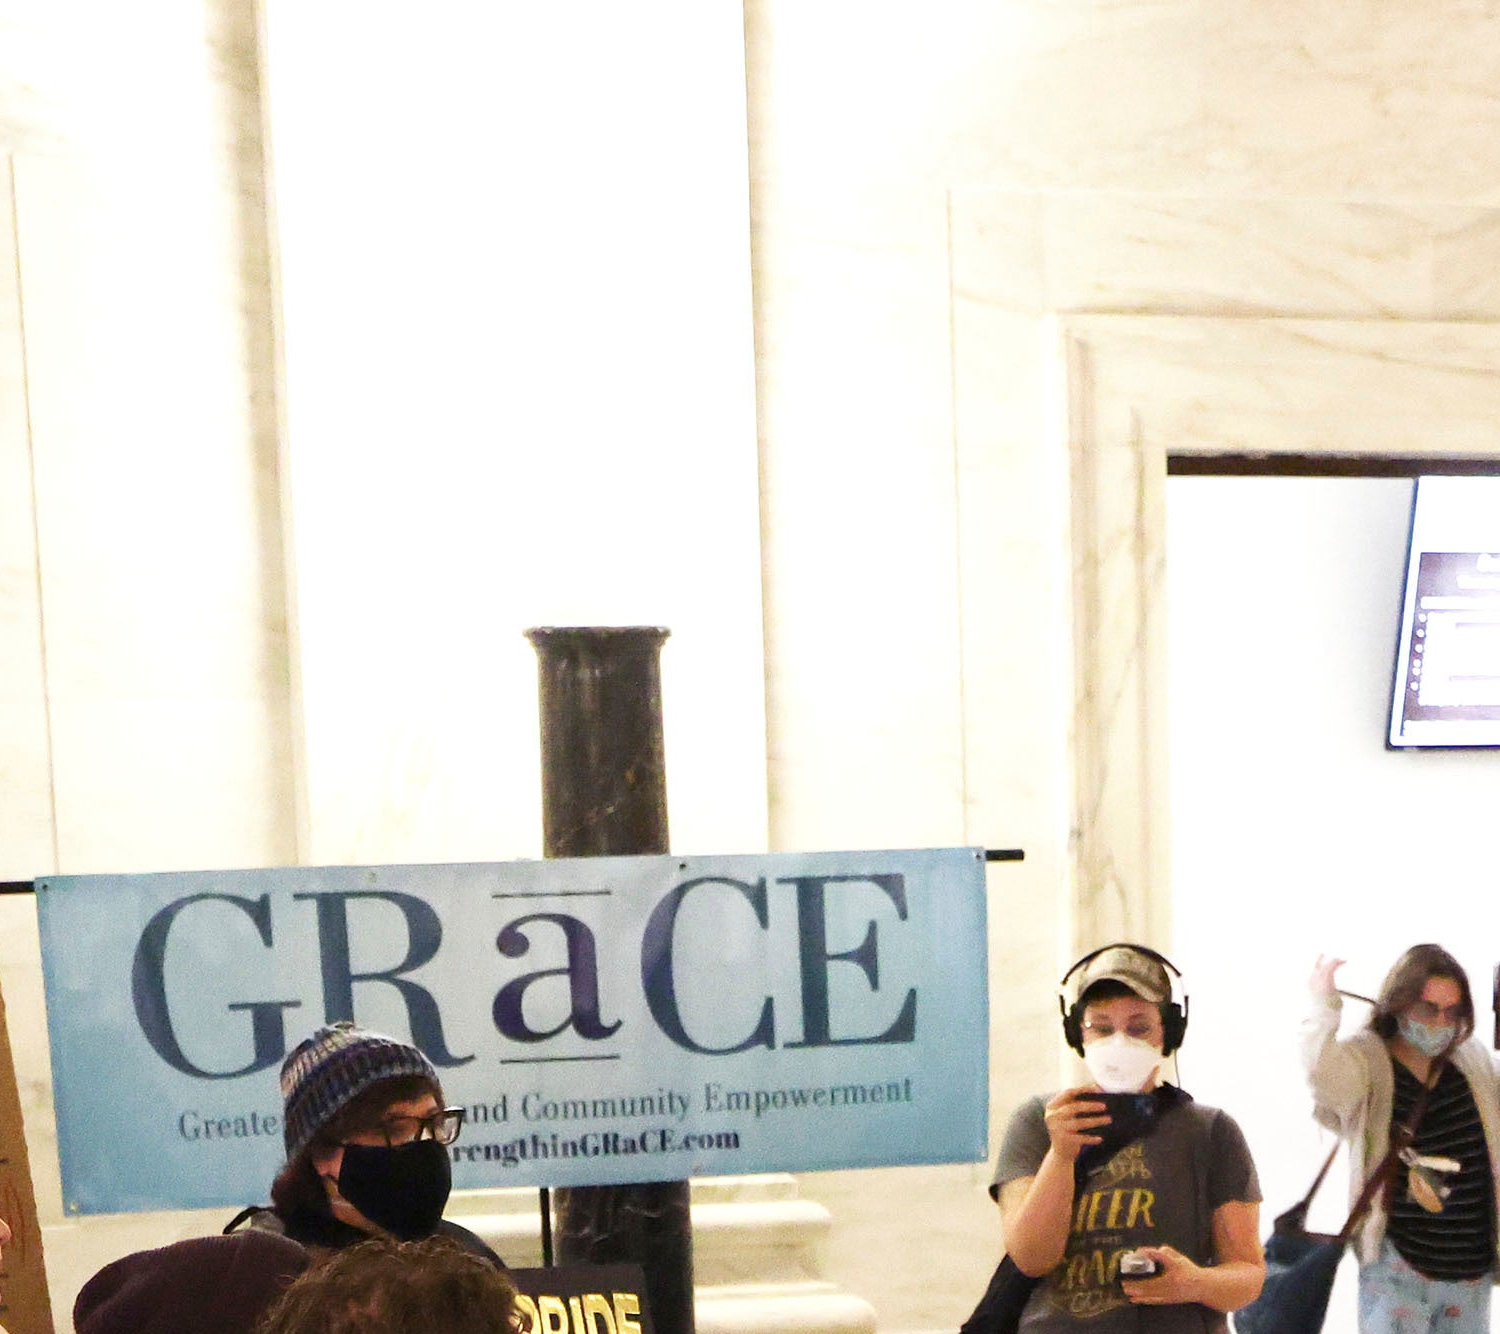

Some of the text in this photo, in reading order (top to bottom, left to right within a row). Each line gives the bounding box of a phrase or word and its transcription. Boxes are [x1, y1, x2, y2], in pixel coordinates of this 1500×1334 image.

[180, 1079, 914, 1140] Greate nd Community Empowerment
[452, 1129, 740, 1168] rengthinGRaCE.com
